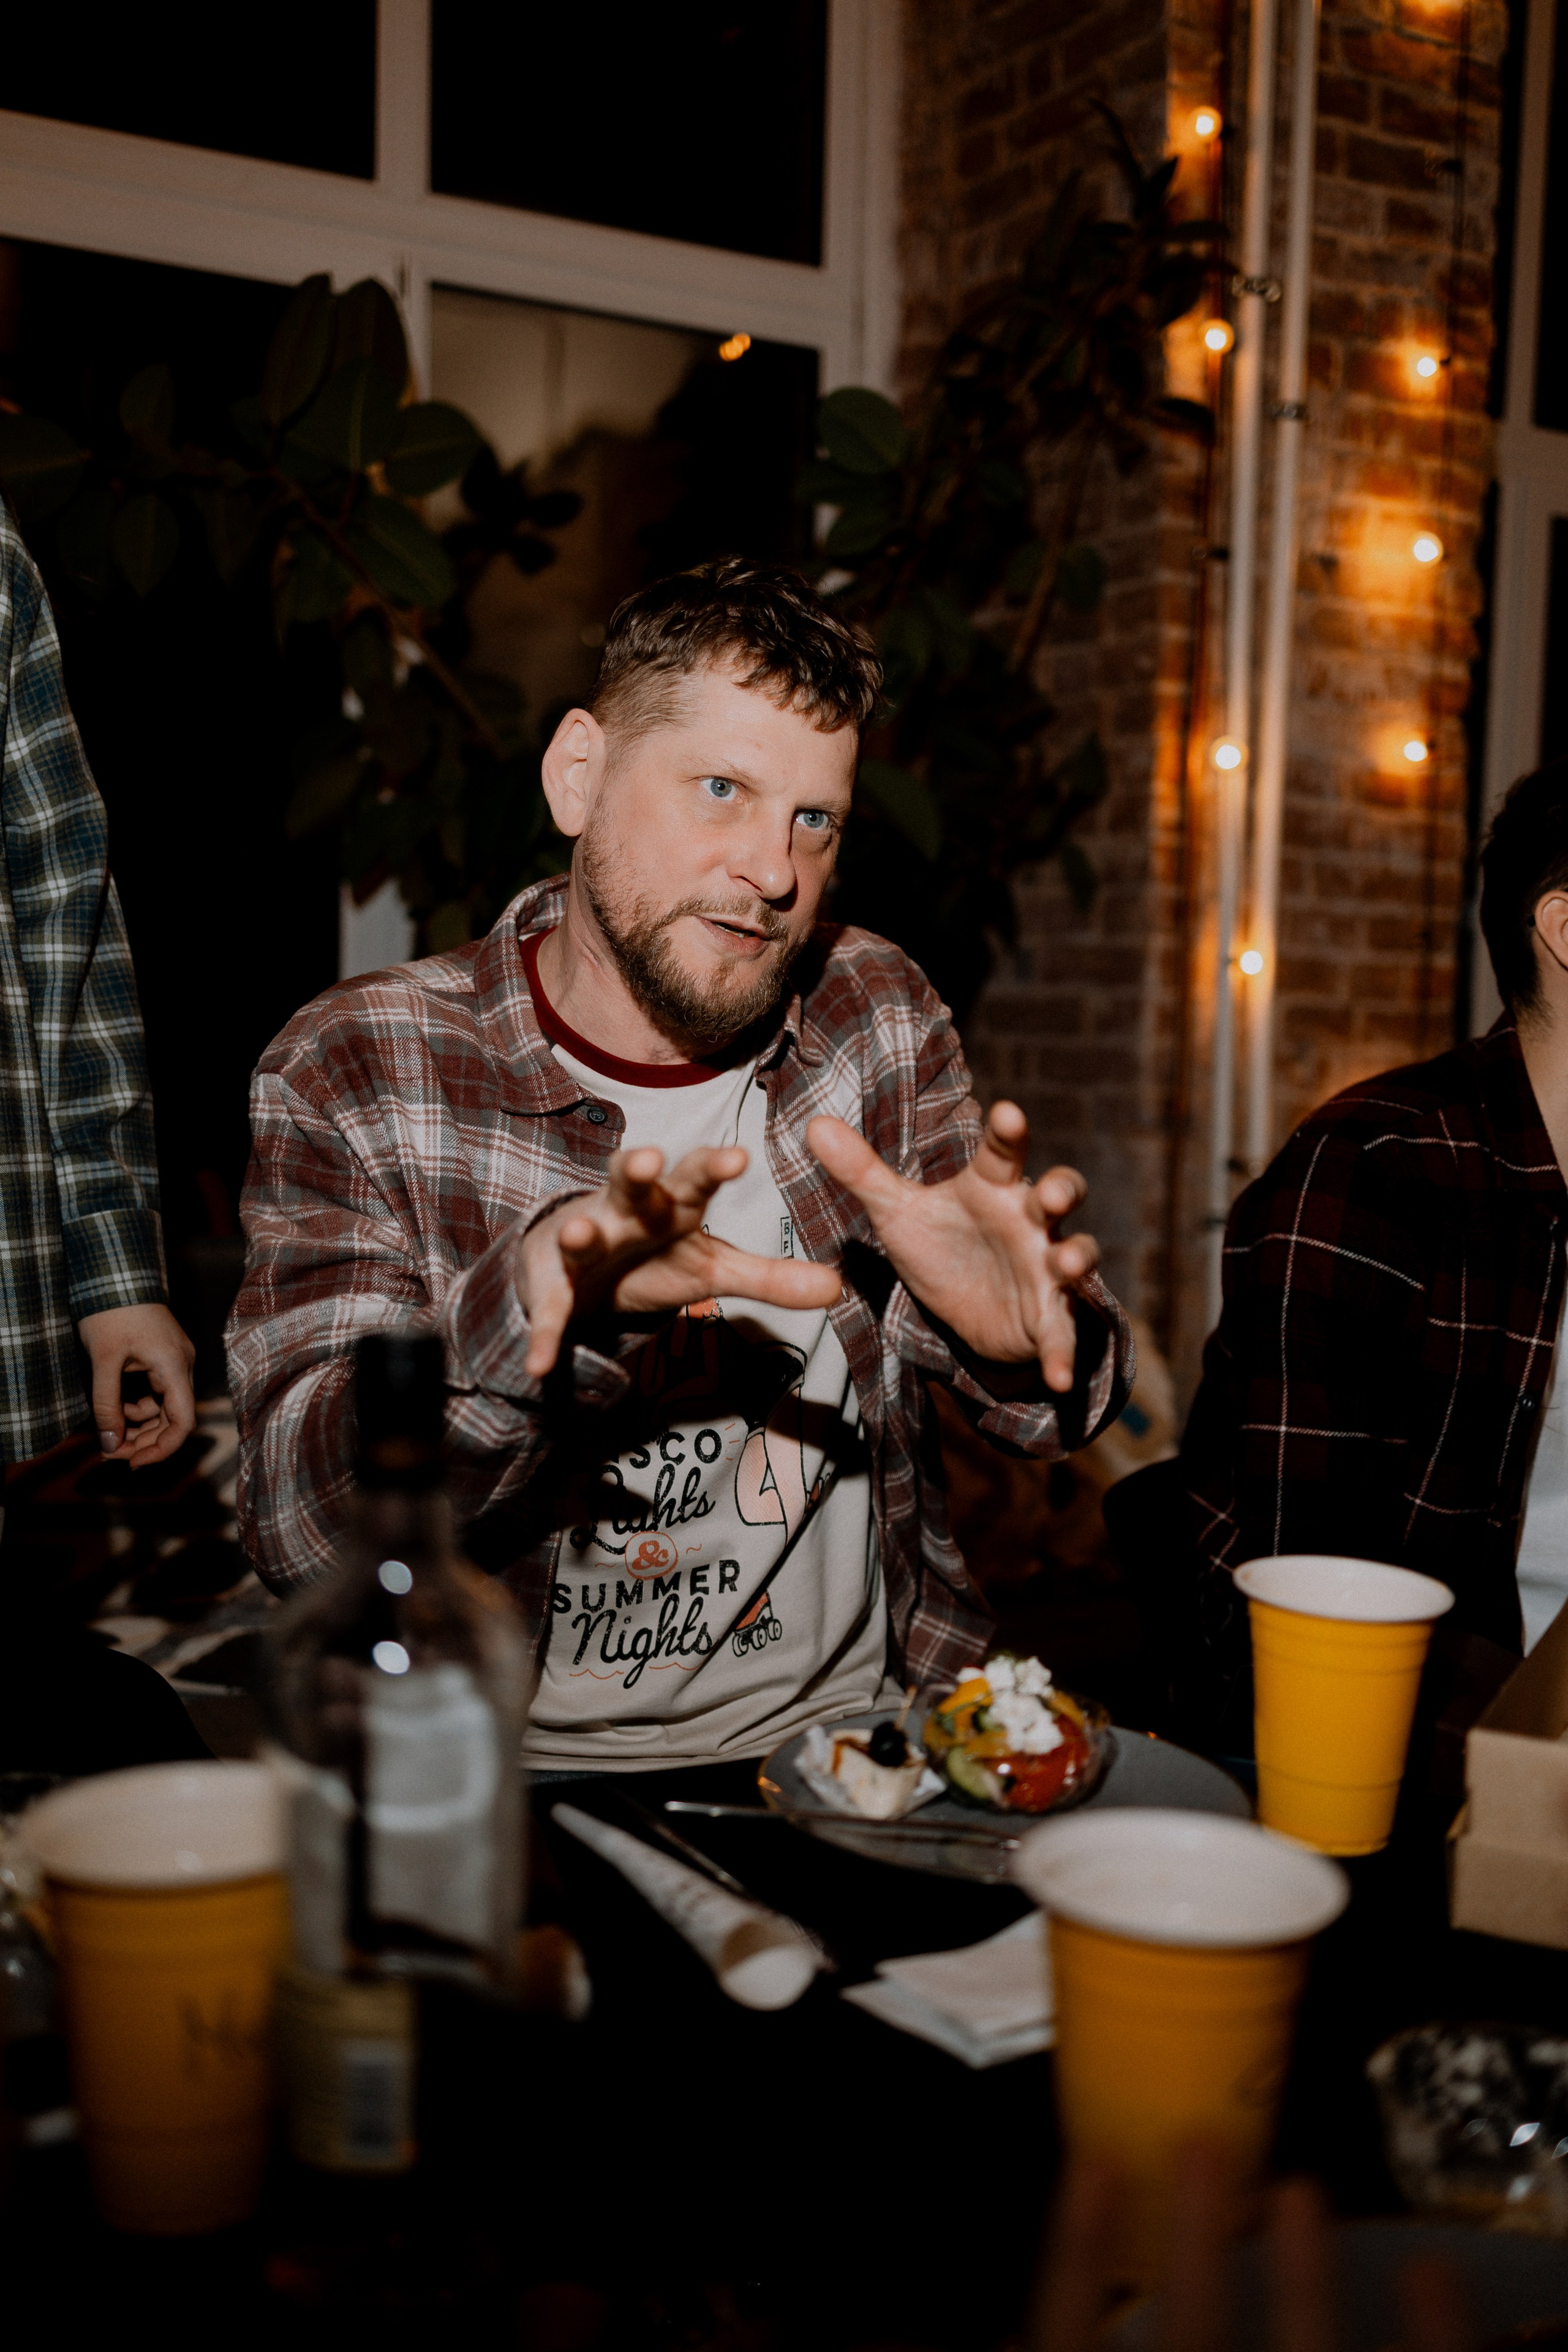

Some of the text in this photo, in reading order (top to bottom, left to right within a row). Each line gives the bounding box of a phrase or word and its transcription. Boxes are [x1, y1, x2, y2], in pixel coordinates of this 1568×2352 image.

[612, 1428, 722, 1469] SCO
[552, 1559, 741, 1615] SUMMER
[571, 1594, 715, 1689] Nights
